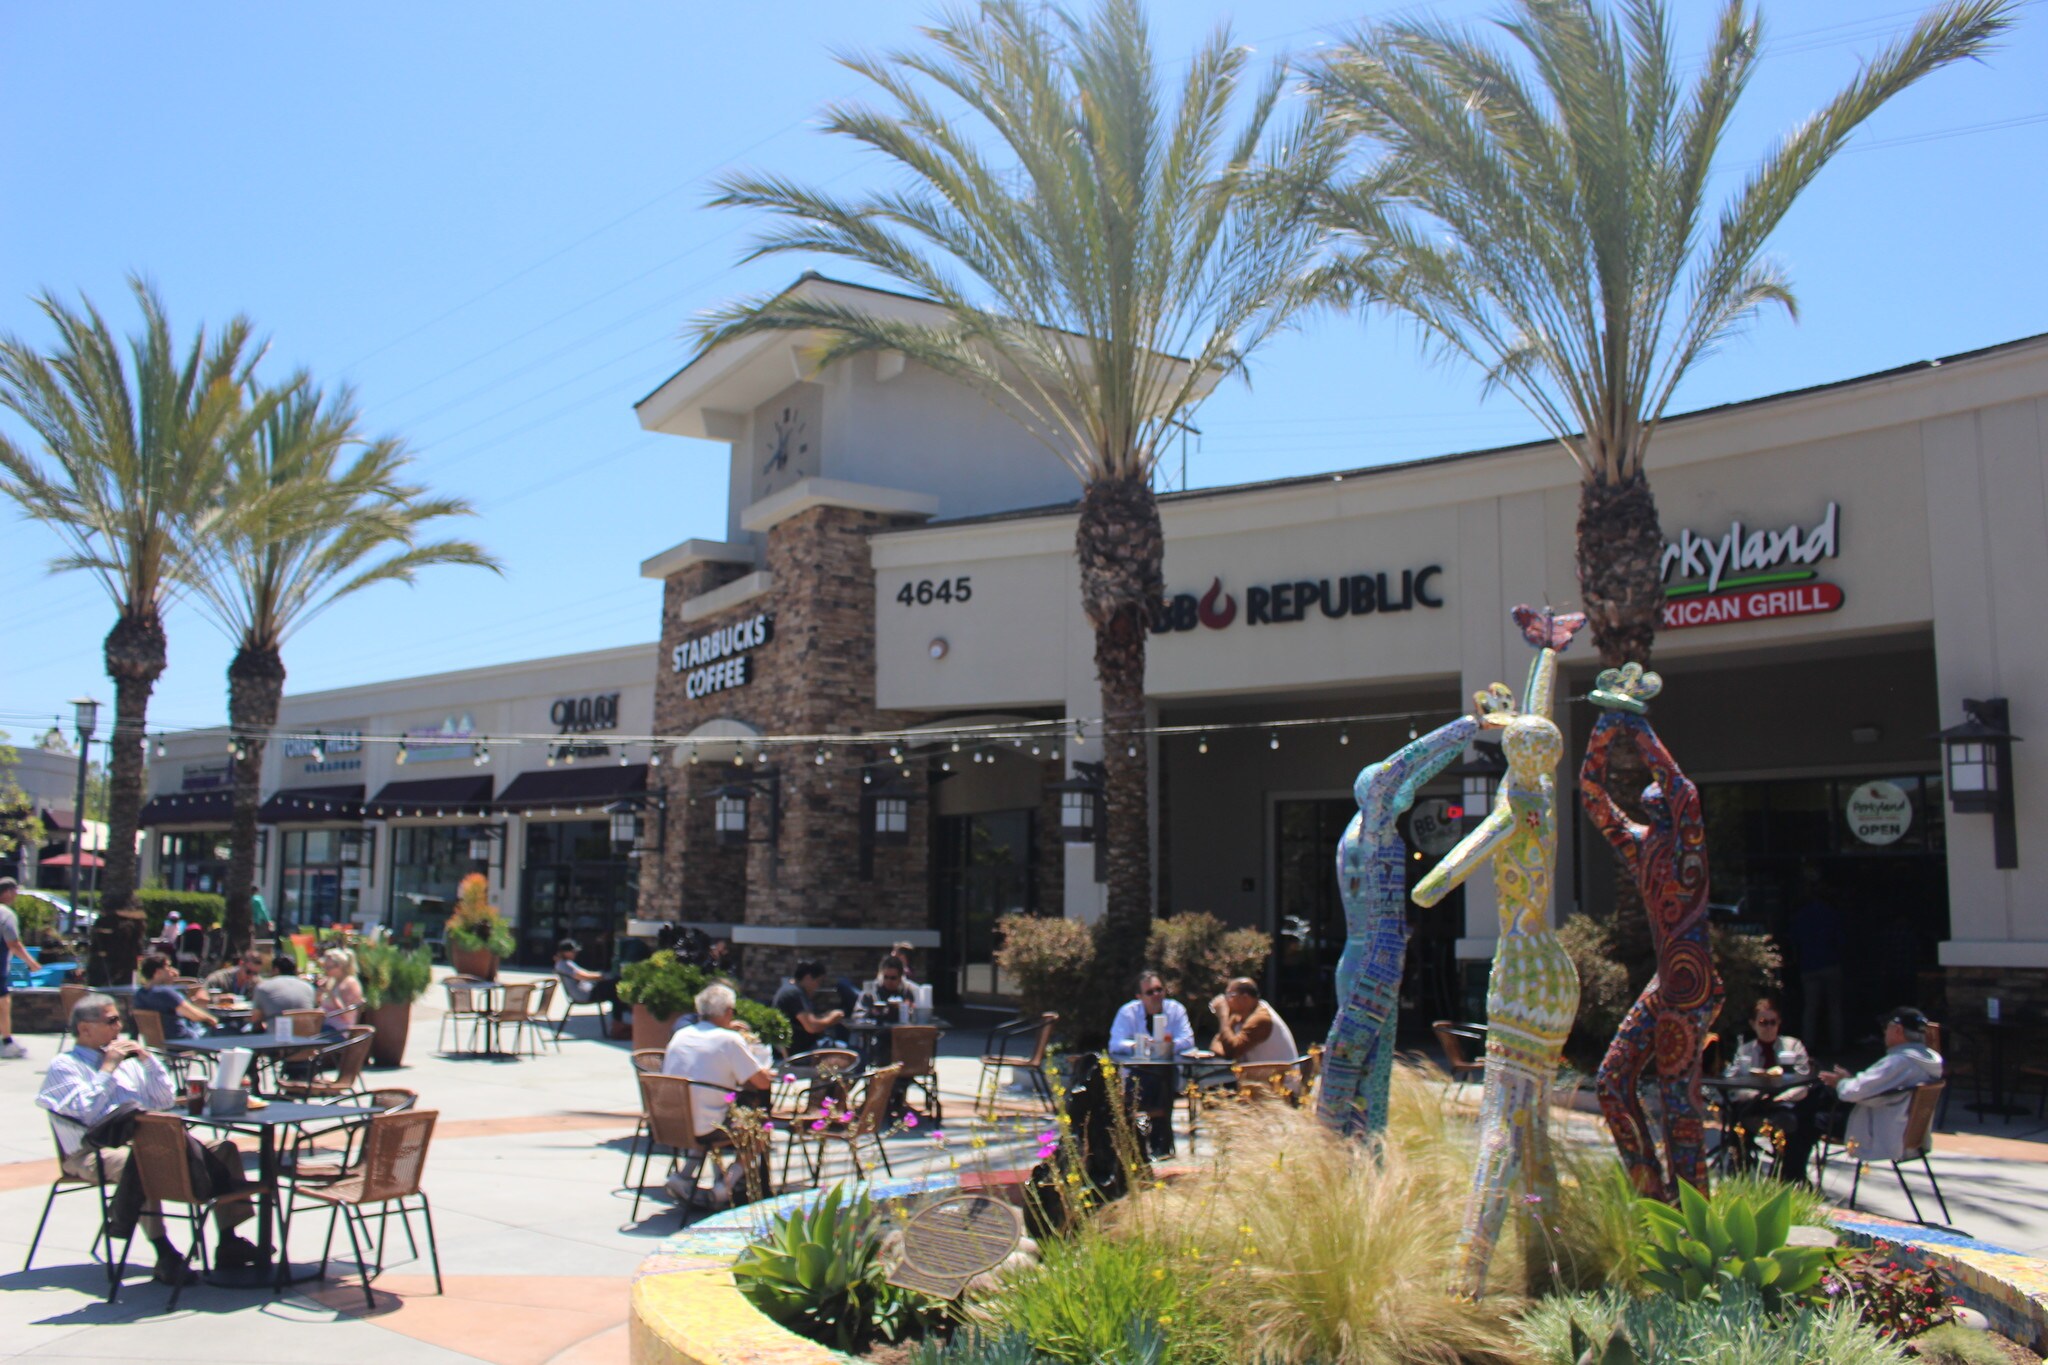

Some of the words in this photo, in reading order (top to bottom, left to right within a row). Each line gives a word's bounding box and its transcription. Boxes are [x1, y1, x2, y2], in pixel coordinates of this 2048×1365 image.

[896, 576, 973, 606] 4645
[1246, 564, 1443, 625] REPUBLIC
[1747, 587, 1829, 617] GRILL
[672, 613, 767, 673] STARBUCKS
[685, 656, 747, 700] COFFEE
[1859, 823, 1900, 836] OPEN
